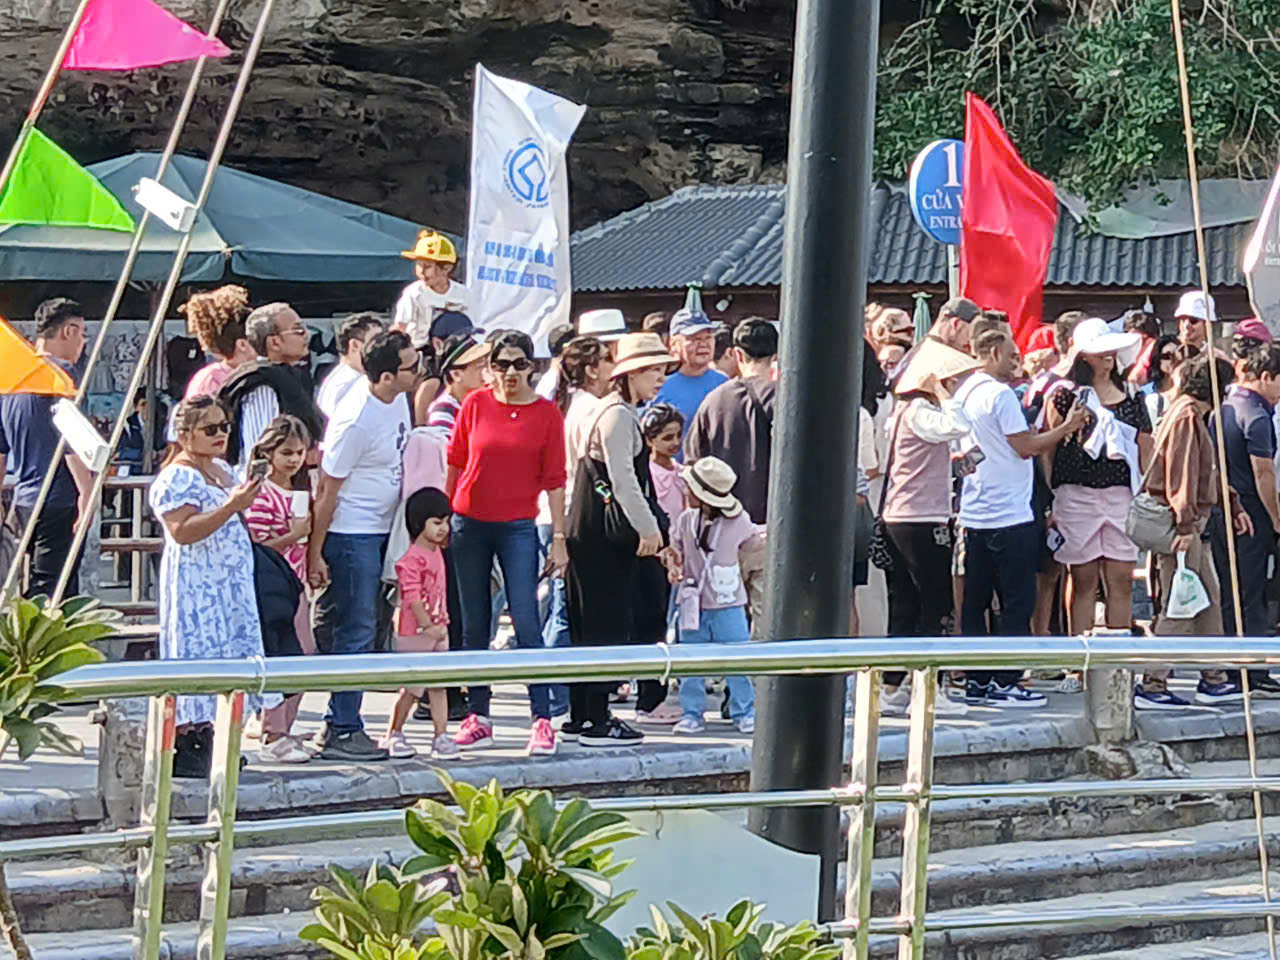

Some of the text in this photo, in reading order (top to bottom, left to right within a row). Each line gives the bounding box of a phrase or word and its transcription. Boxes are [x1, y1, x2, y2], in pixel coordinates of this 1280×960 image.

[942, 142, 961, 187] 1
[921, 188, 953, 210] CỬA
[929, 215, 964, 230] ENTRA
